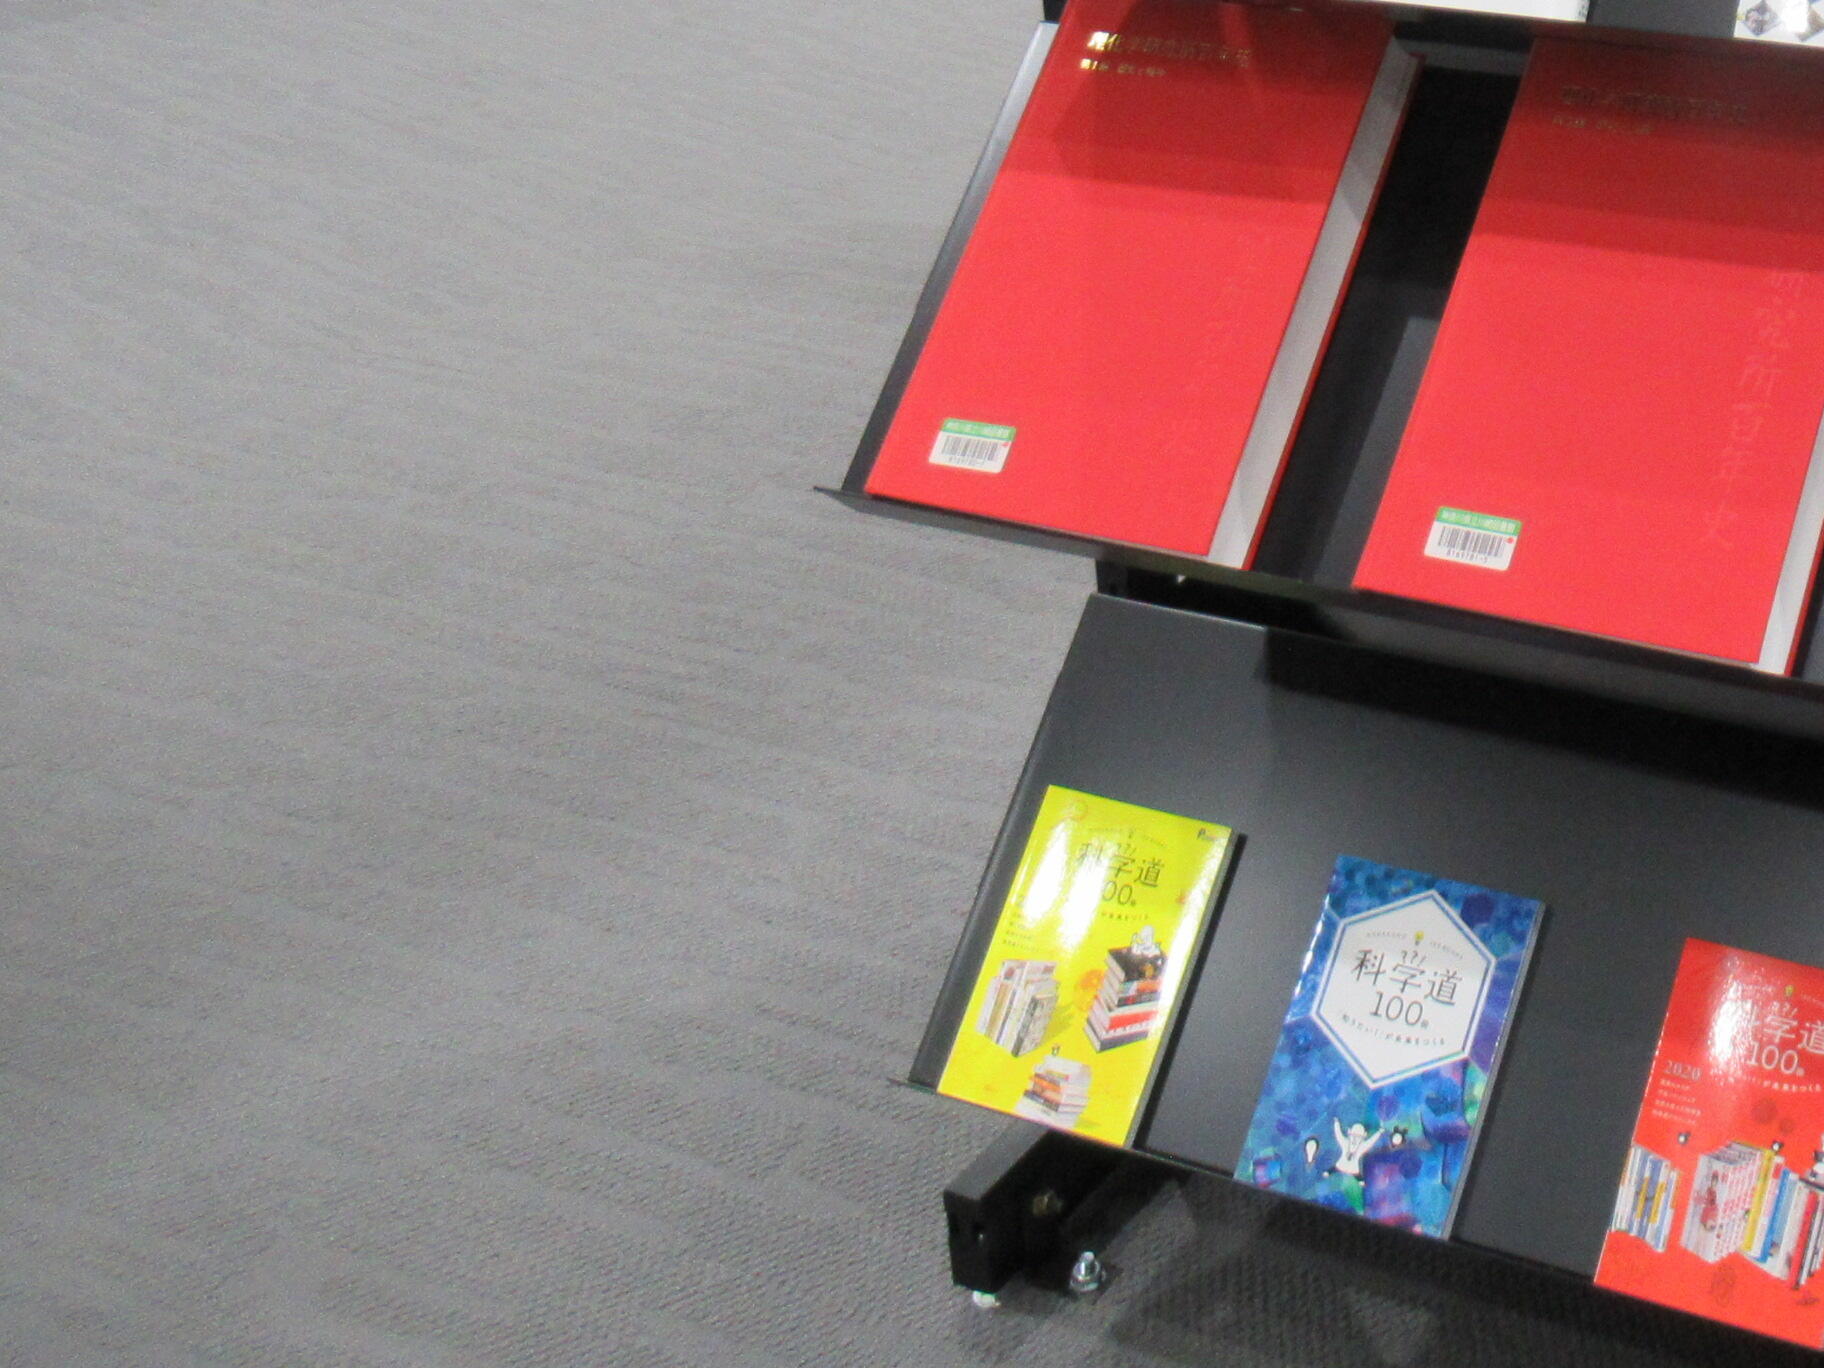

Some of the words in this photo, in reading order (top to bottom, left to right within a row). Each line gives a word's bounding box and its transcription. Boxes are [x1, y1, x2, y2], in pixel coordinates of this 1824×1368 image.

[1351, 948, 1463, 1006] 科学道
[1664, 1060, 1701, 1082] 2020
